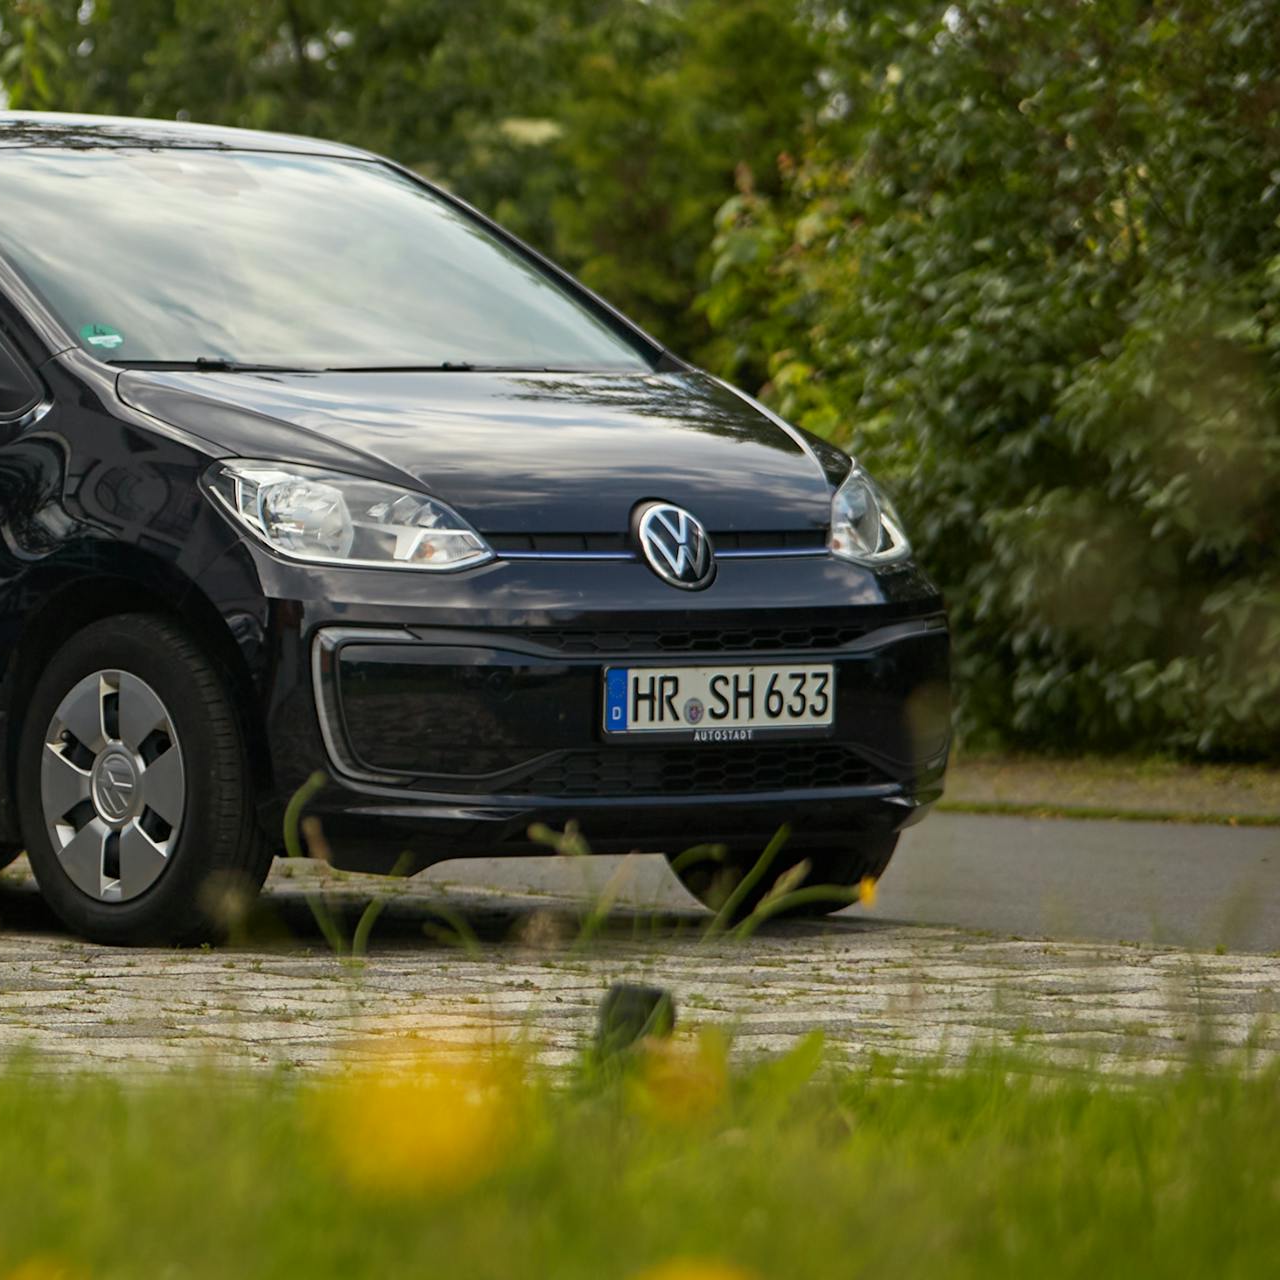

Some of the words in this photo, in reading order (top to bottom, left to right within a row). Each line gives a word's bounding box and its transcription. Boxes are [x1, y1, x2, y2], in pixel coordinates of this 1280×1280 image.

[632, 676, 679, 722] HR
[708, 673, 755, 720] SH
[764, 673, 829, 719] 633
[612, 706, 621, 720] D
[693, 730, 753, 741] AUTOSTADT
